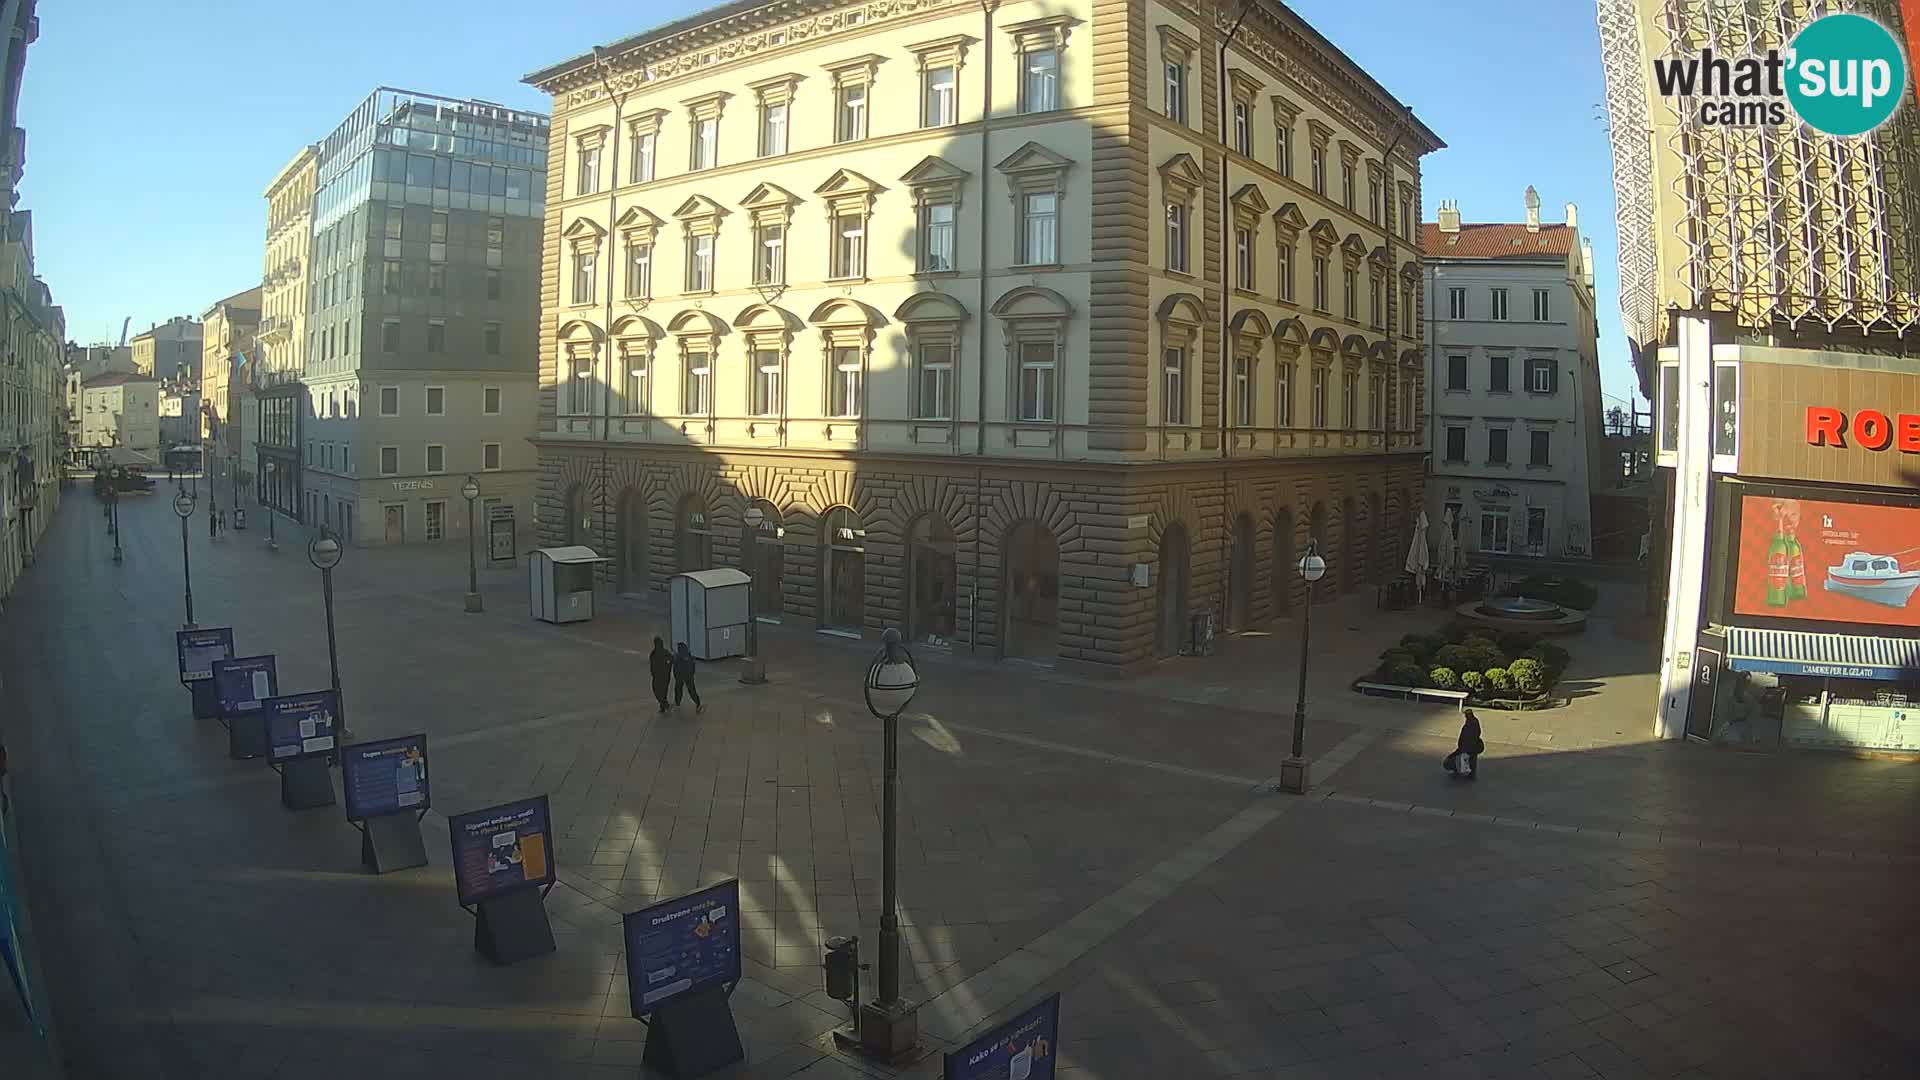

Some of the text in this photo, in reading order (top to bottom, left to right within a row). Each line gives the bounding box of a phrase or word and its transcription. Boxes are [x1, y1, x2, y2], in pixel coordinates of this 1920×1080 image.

[392, 481, 433, 490] TEZENIS
[1823, 515, 1832, 528] 1x
[1702, 665, 1710, 681] a
[1802, 665, 1829, 675] L'AMORE
[1829, 667, 1842, 675] PER
[1849, 668, 1873, 677] GELATO
